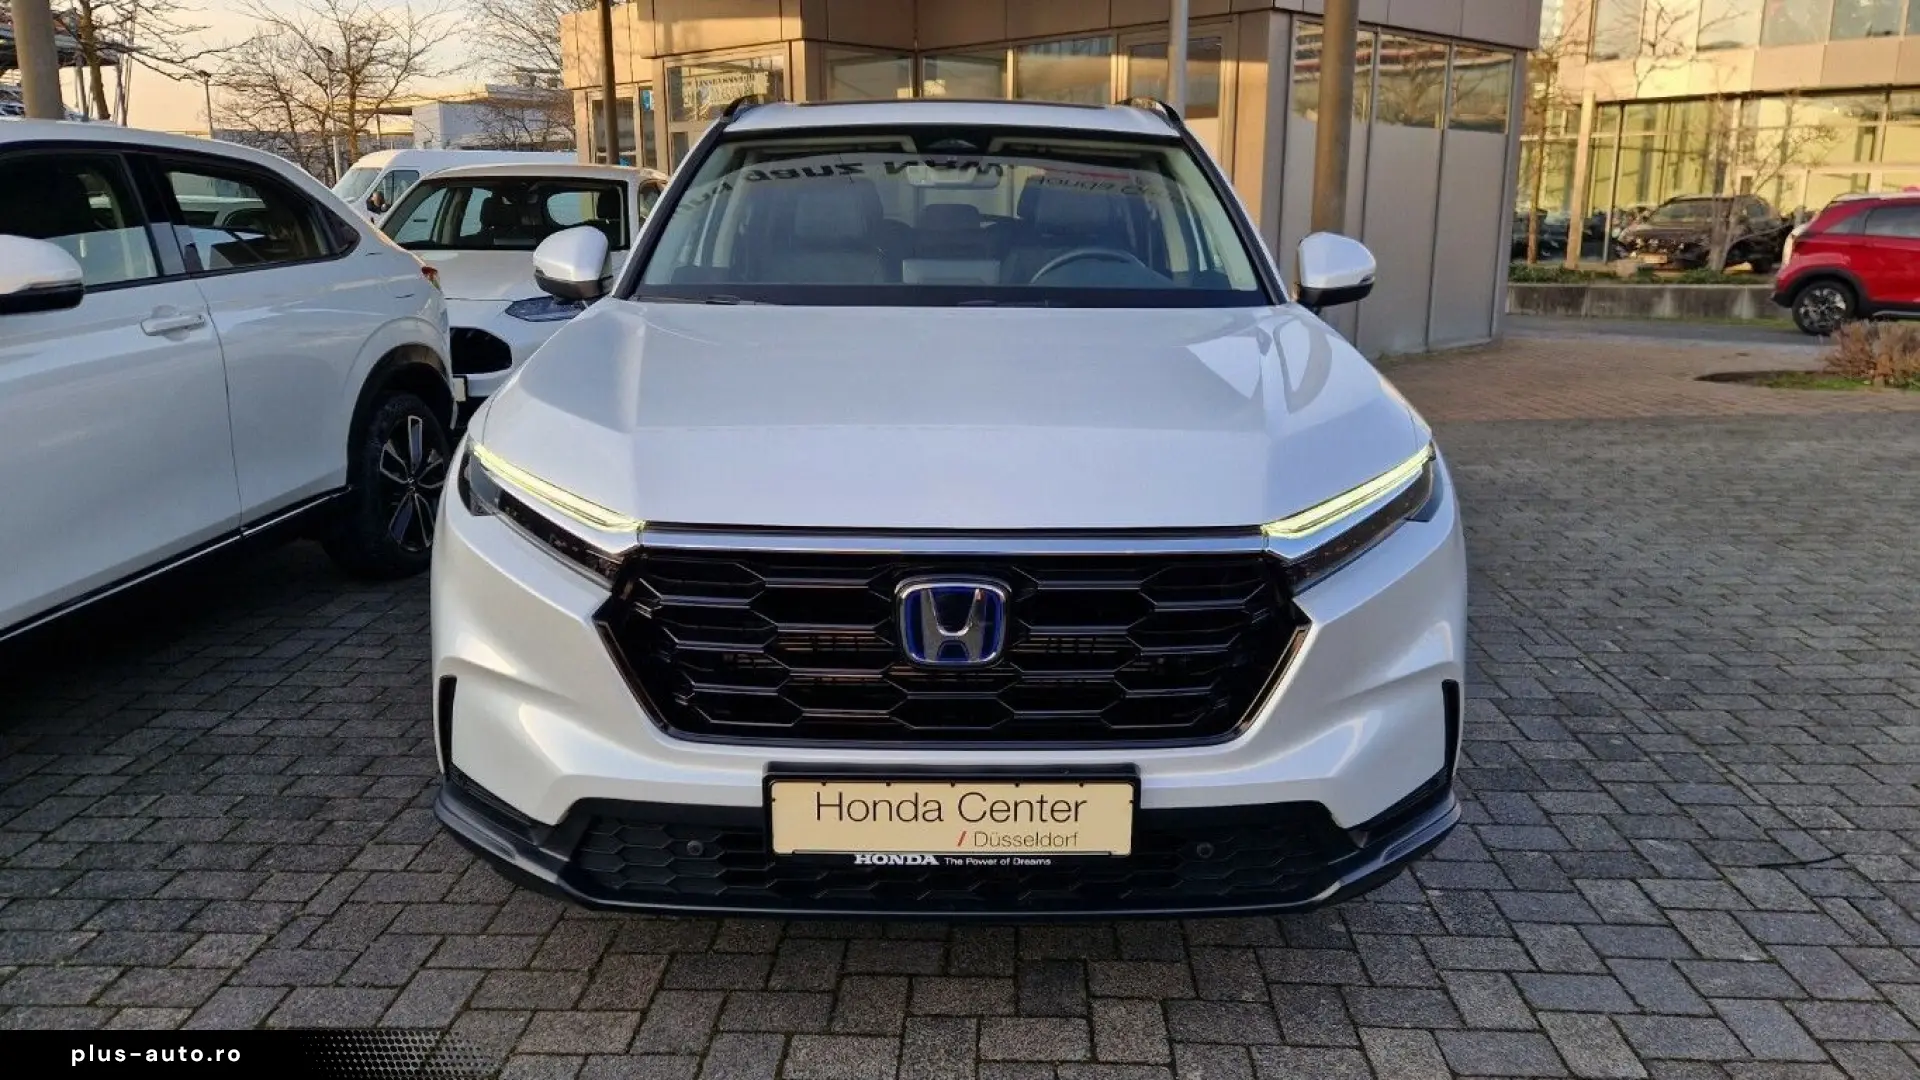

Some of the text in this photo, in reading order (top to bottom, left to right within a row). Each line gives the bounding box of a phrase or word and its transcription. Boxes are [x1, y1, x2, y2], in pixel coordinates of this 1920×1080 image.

[816, 791, 1087, 822] Honda Center
[974, 830, 1078, 848] Düsseldorf
[854, 854, 1051, 866] HONDA The Power of Dreams
